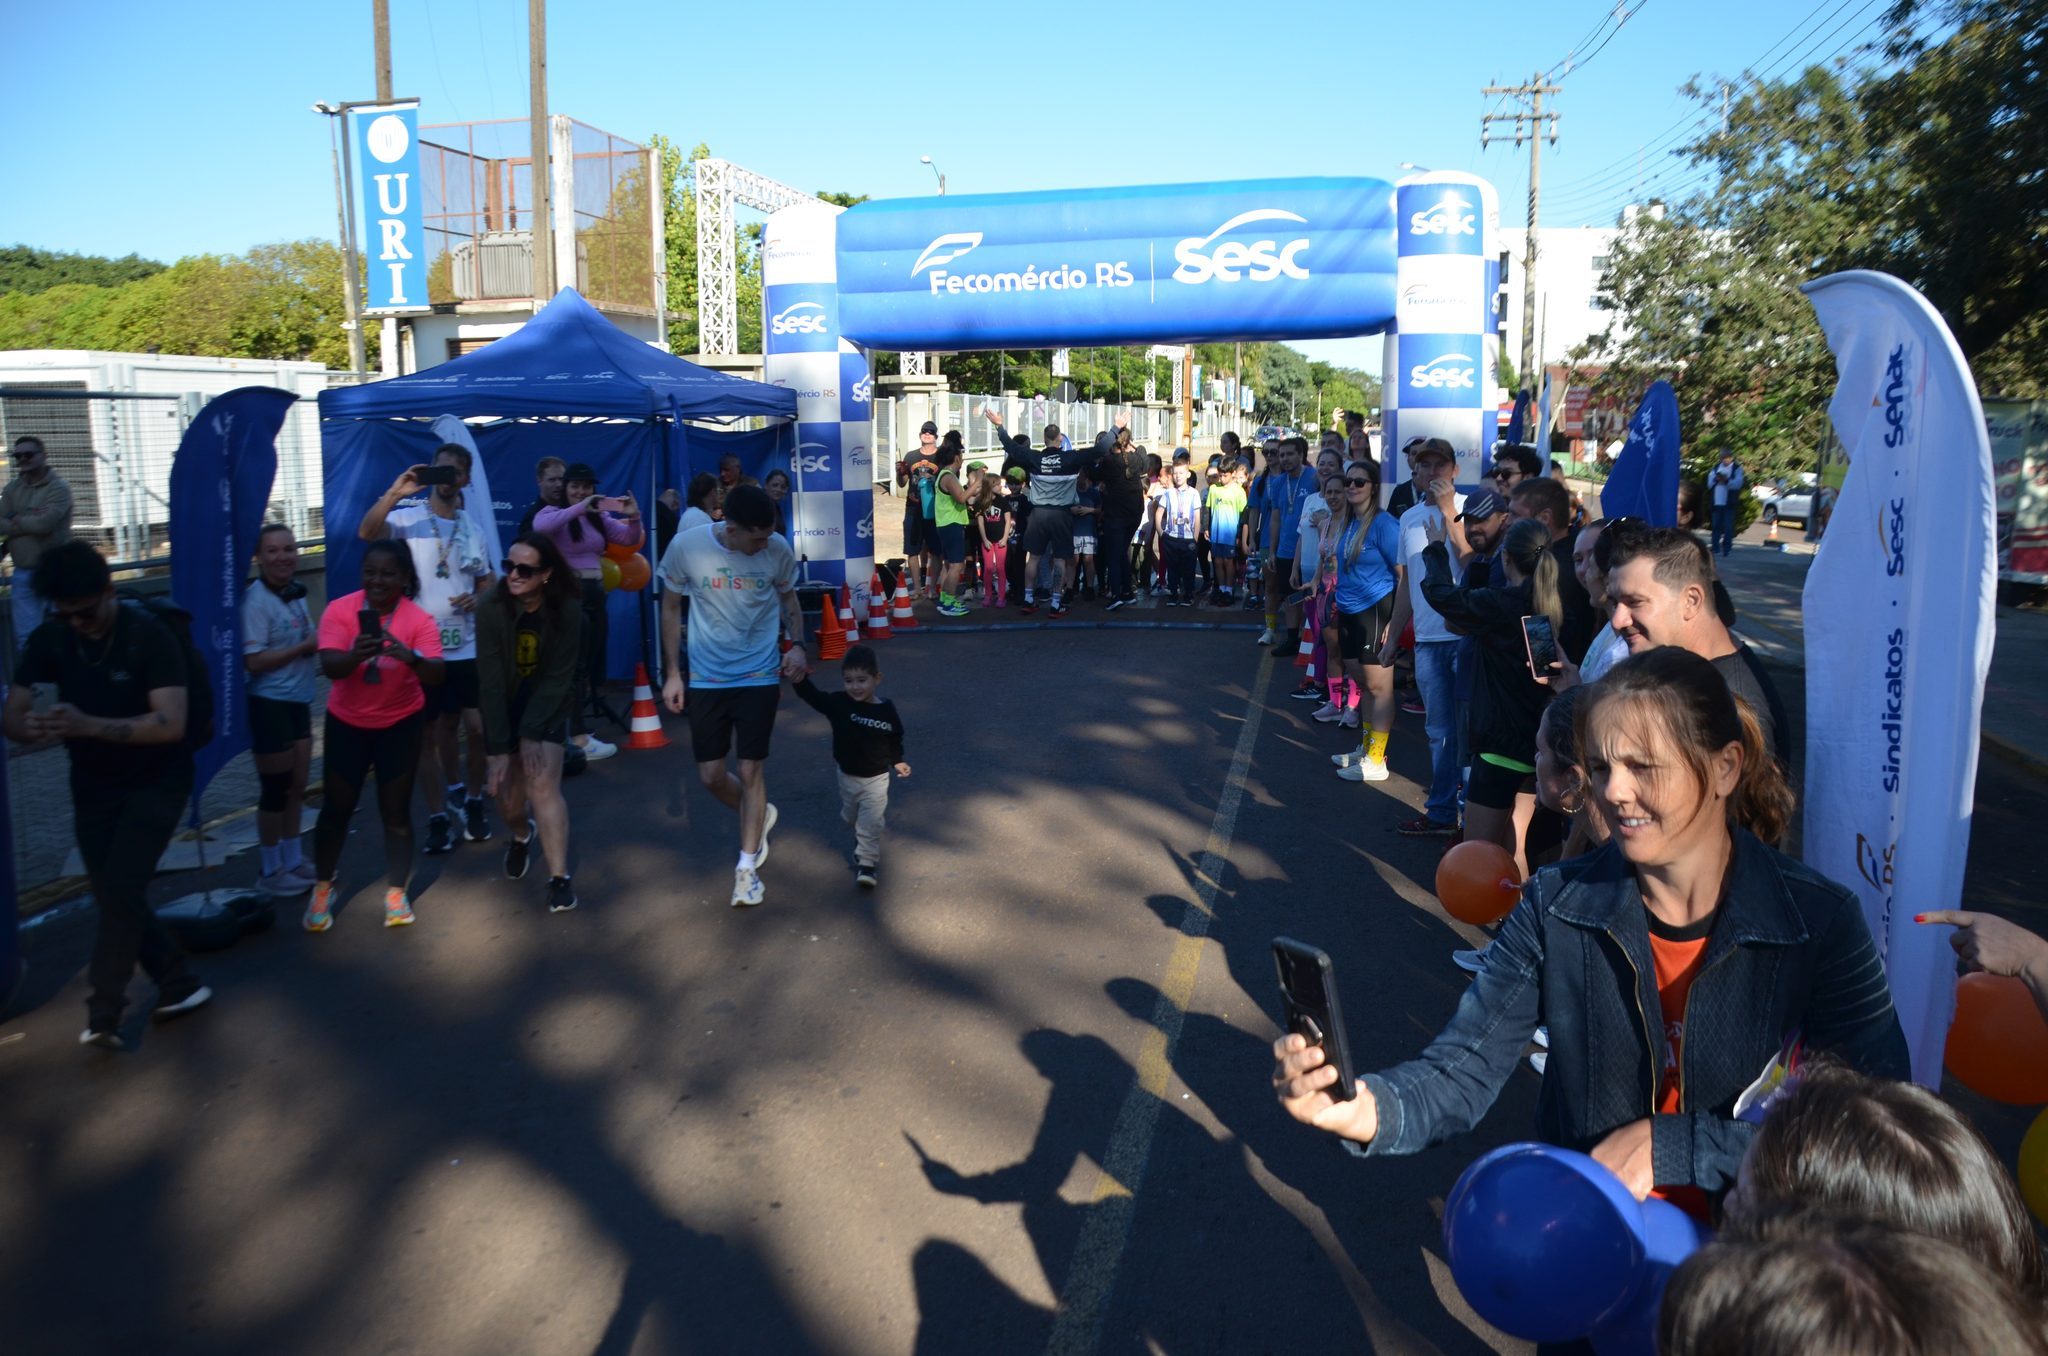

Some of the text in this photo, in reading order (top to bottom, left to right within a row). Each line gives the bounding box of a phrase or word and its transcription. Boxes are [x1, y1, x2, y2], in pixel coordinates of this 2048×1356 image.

[1410, 211, 1475, 235] Sesc
[373, 173, 413, 304] URI
[929, 236, 1309, 295] Fecomércio RS Sesc
[772, 314, 827, 335] Sesc
[1410, 365, 1474, 388] Sesc
[797, 388, 836, 398] ércio RS
[852, 382, 871, 402] Se
[1884, 343, 1904, 449] Senac
[790, 455, 831, 473] esc
[828, 527, 840, 536] RS
[1887, 497, 1904, 577] Sesc
[702, 575, 765, 591] Autismo
[1882, 628, 1903, 794] Sindicatos
